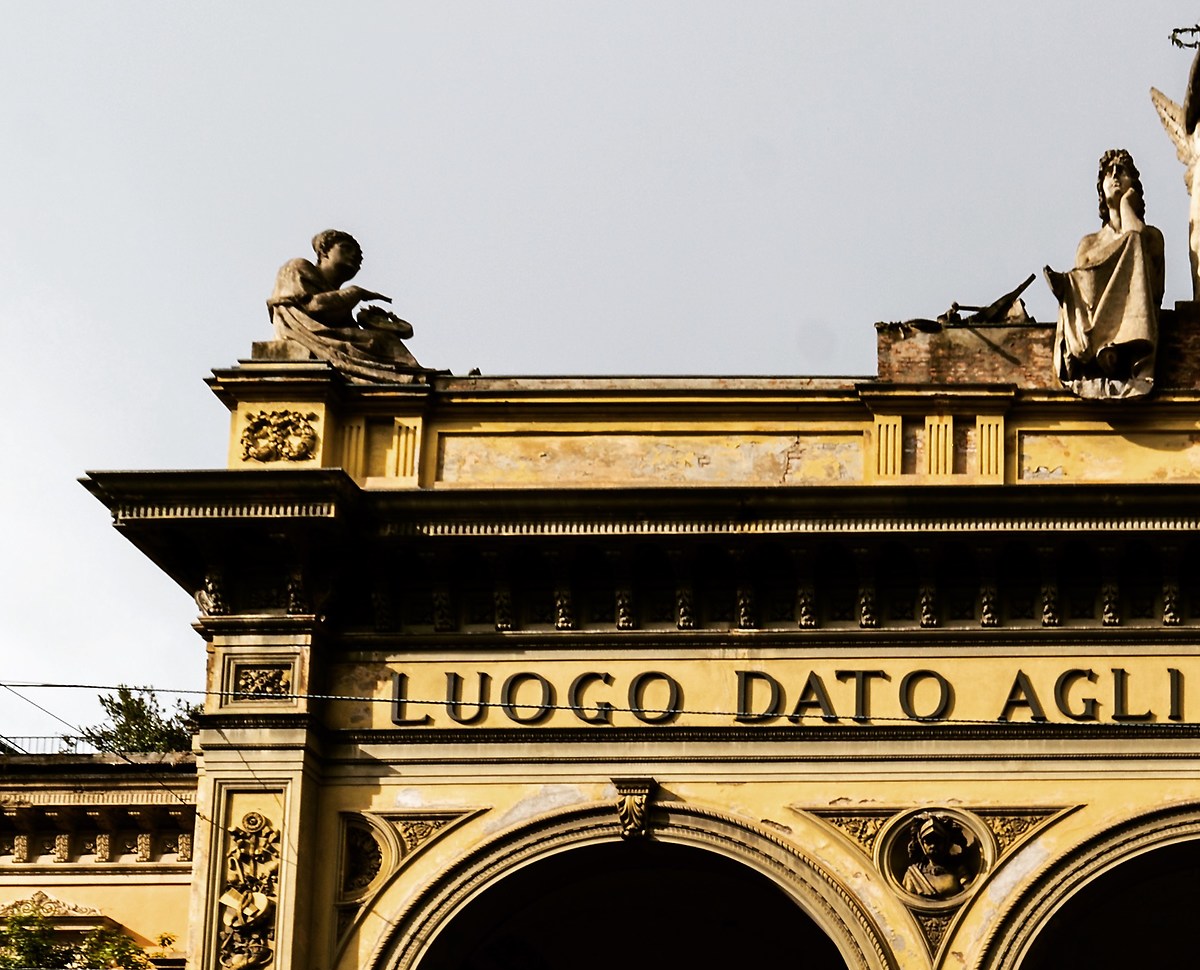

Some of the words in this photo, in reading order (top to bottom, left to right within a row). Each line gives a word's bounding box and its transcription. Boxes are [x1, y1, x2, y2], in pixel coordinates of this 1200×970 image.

[388, 669, 685, 727] LUOGO
[733, 669, 956, 724] DATO
[997, 667, 1185, 723] AGLI
